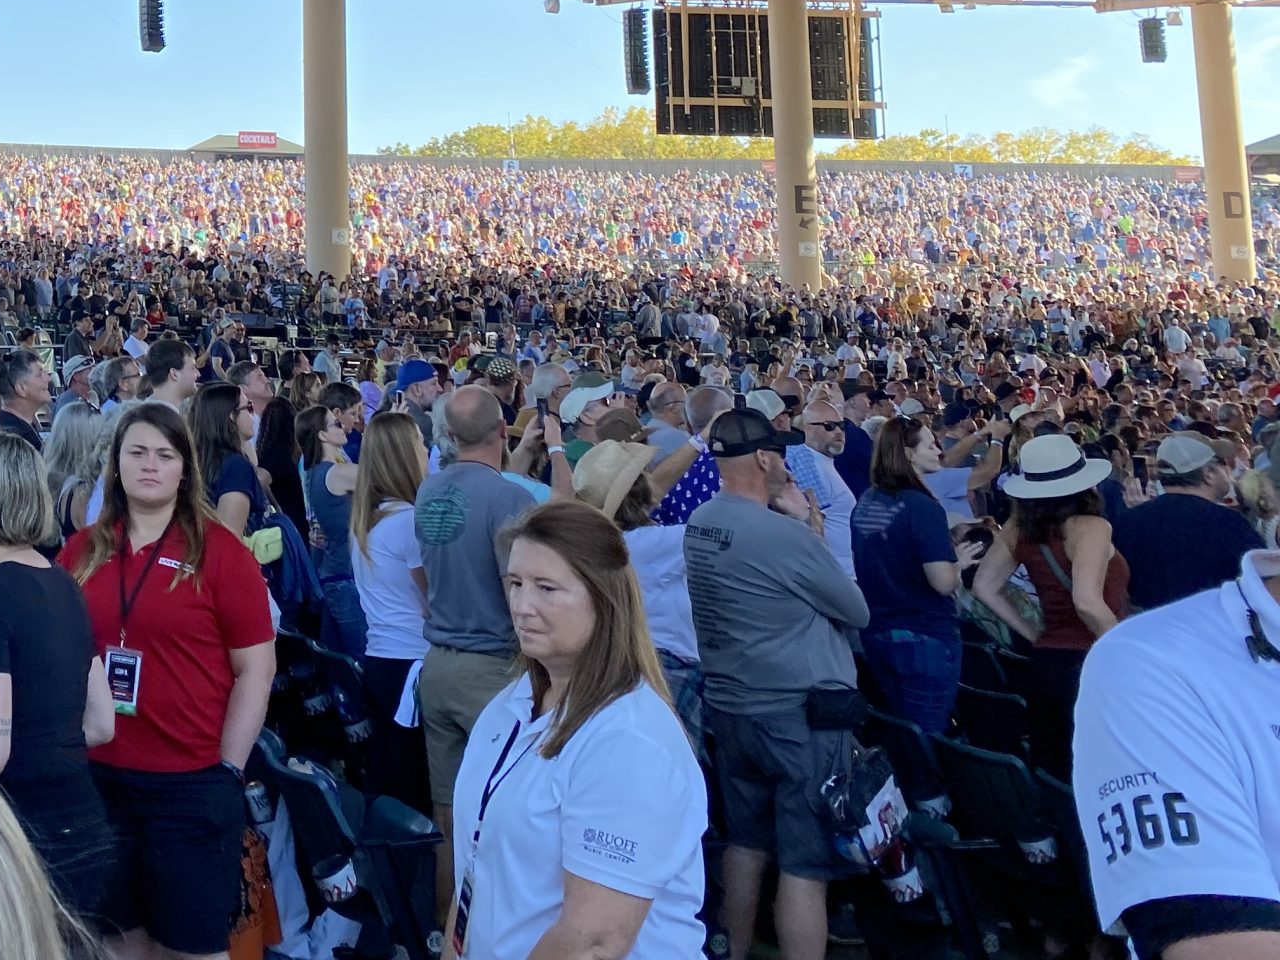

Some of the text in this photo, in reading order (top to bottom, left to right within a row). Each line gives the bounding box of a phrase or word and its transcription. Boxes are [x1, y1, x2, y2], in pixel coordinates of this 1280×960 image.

[240, 135, 275, 144] COCKTAILS
[959, 165, 968, 177] 7
[795, 185, 816, 213] E
[1223, 192, 1245, 218] D
[1098, 772, 1159, 800] SECURITY
[597, 830, 638, 852] RUOFF
[1097, 792, 1200, 865] 5366
